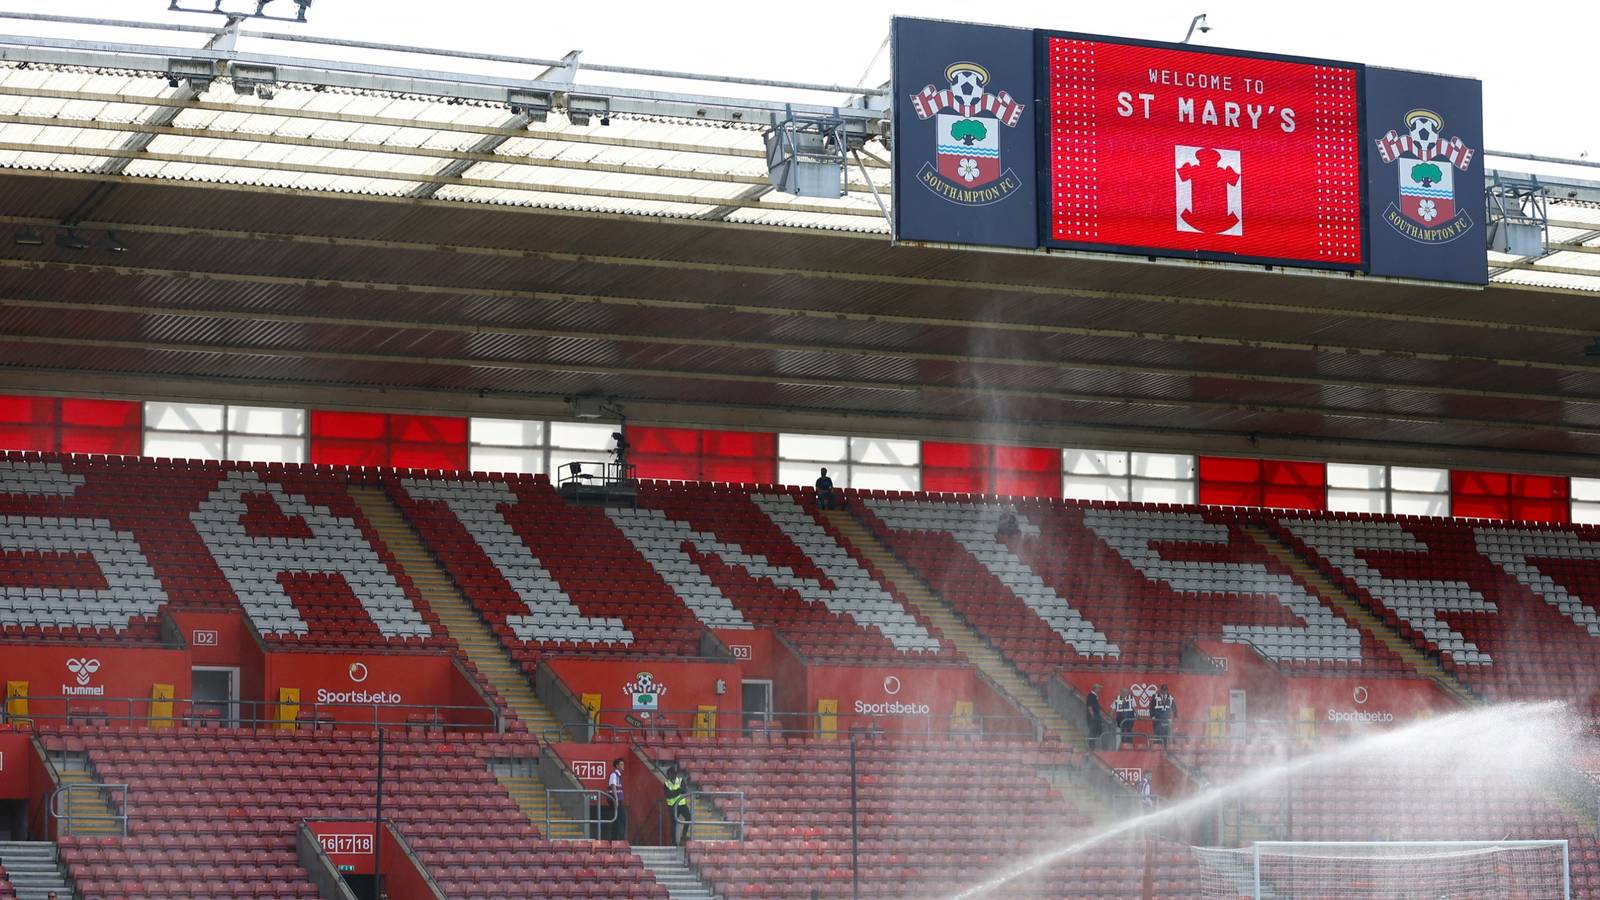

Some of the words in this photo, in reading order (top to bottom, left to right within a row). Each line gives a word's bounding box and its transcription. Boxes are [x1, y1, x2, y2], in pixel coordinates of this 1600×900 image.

[1149, 68, 1232, 91] WELCOME
[1244, 78, 1264, 94] TO
[1117, 92, 1154, 119] ST
[1178, 97, 1296, 133] MARY'S
[923, 171, 1000, 202] SOUTHAMPTON
[999, 177, 1014, 193] FC
[1388, 211, 1456, 241] SOUTHAMPTON
[1455, 217, 1467, 233] FC
[198, 632, 213, 644] D2
[733, 647, 748, 658] D3
[62, 684, 104, 696] hummel
[317, 688, 401, 704] Sportsbet.io
[854, 700, 930, 714] Sportsbet.io
[1328, 709, 1393, 723] Sportsbet.io
[575, 765, 588, 776] 17
[591, 765, 603, 776] 18
[1128, 771, 1139, 782] 19
[320, 838, 335, 850] 16
[338, 838, 352, 850] 17
[356, 838, 370, 850] 18
